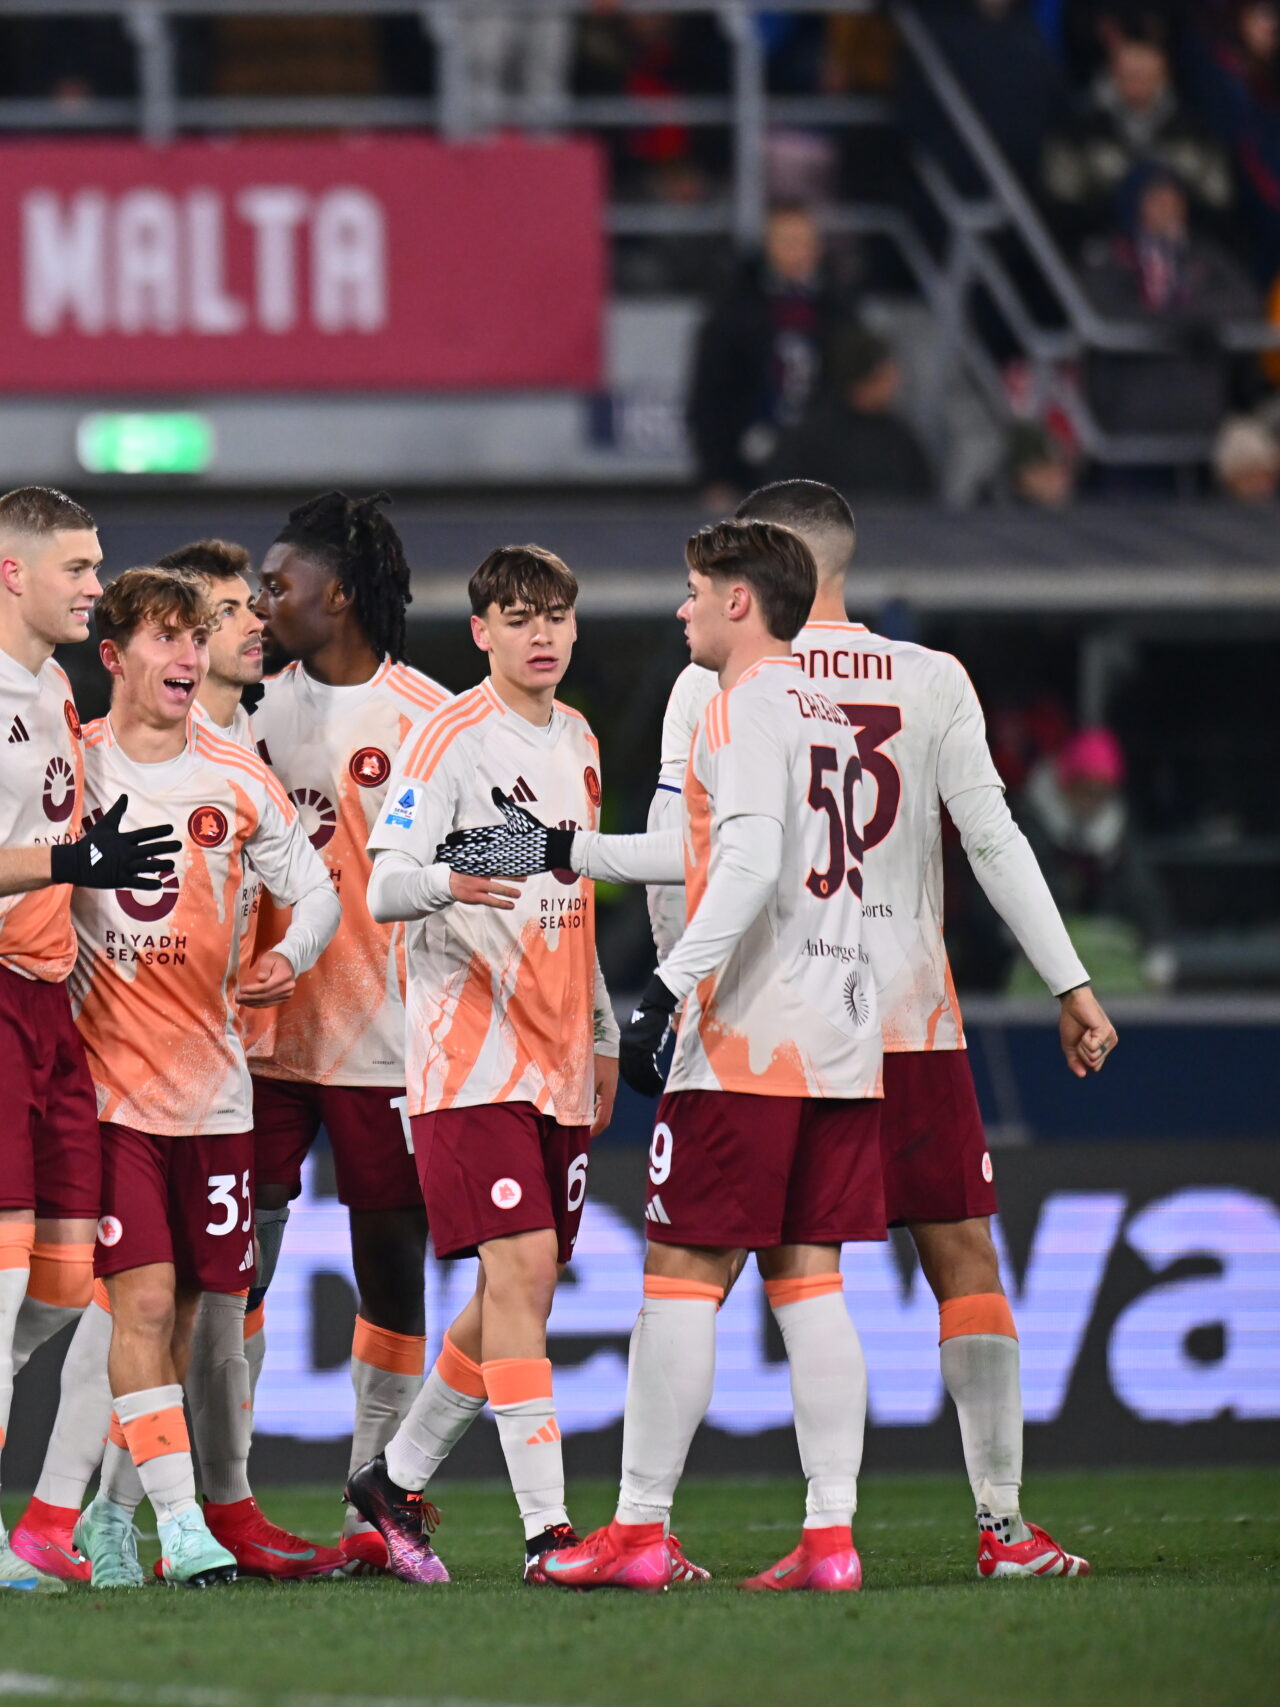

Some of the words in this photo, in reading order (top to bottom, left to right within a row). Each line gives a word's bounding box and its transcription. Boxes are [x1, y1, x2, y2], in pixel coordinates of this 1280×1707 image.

[24, 187, 386, 336] MALTA
[106, 930, 187, 949] RIYADH
[106, 947, 186, 965] SEASON
[205, 1168, 252, 1236] 35
